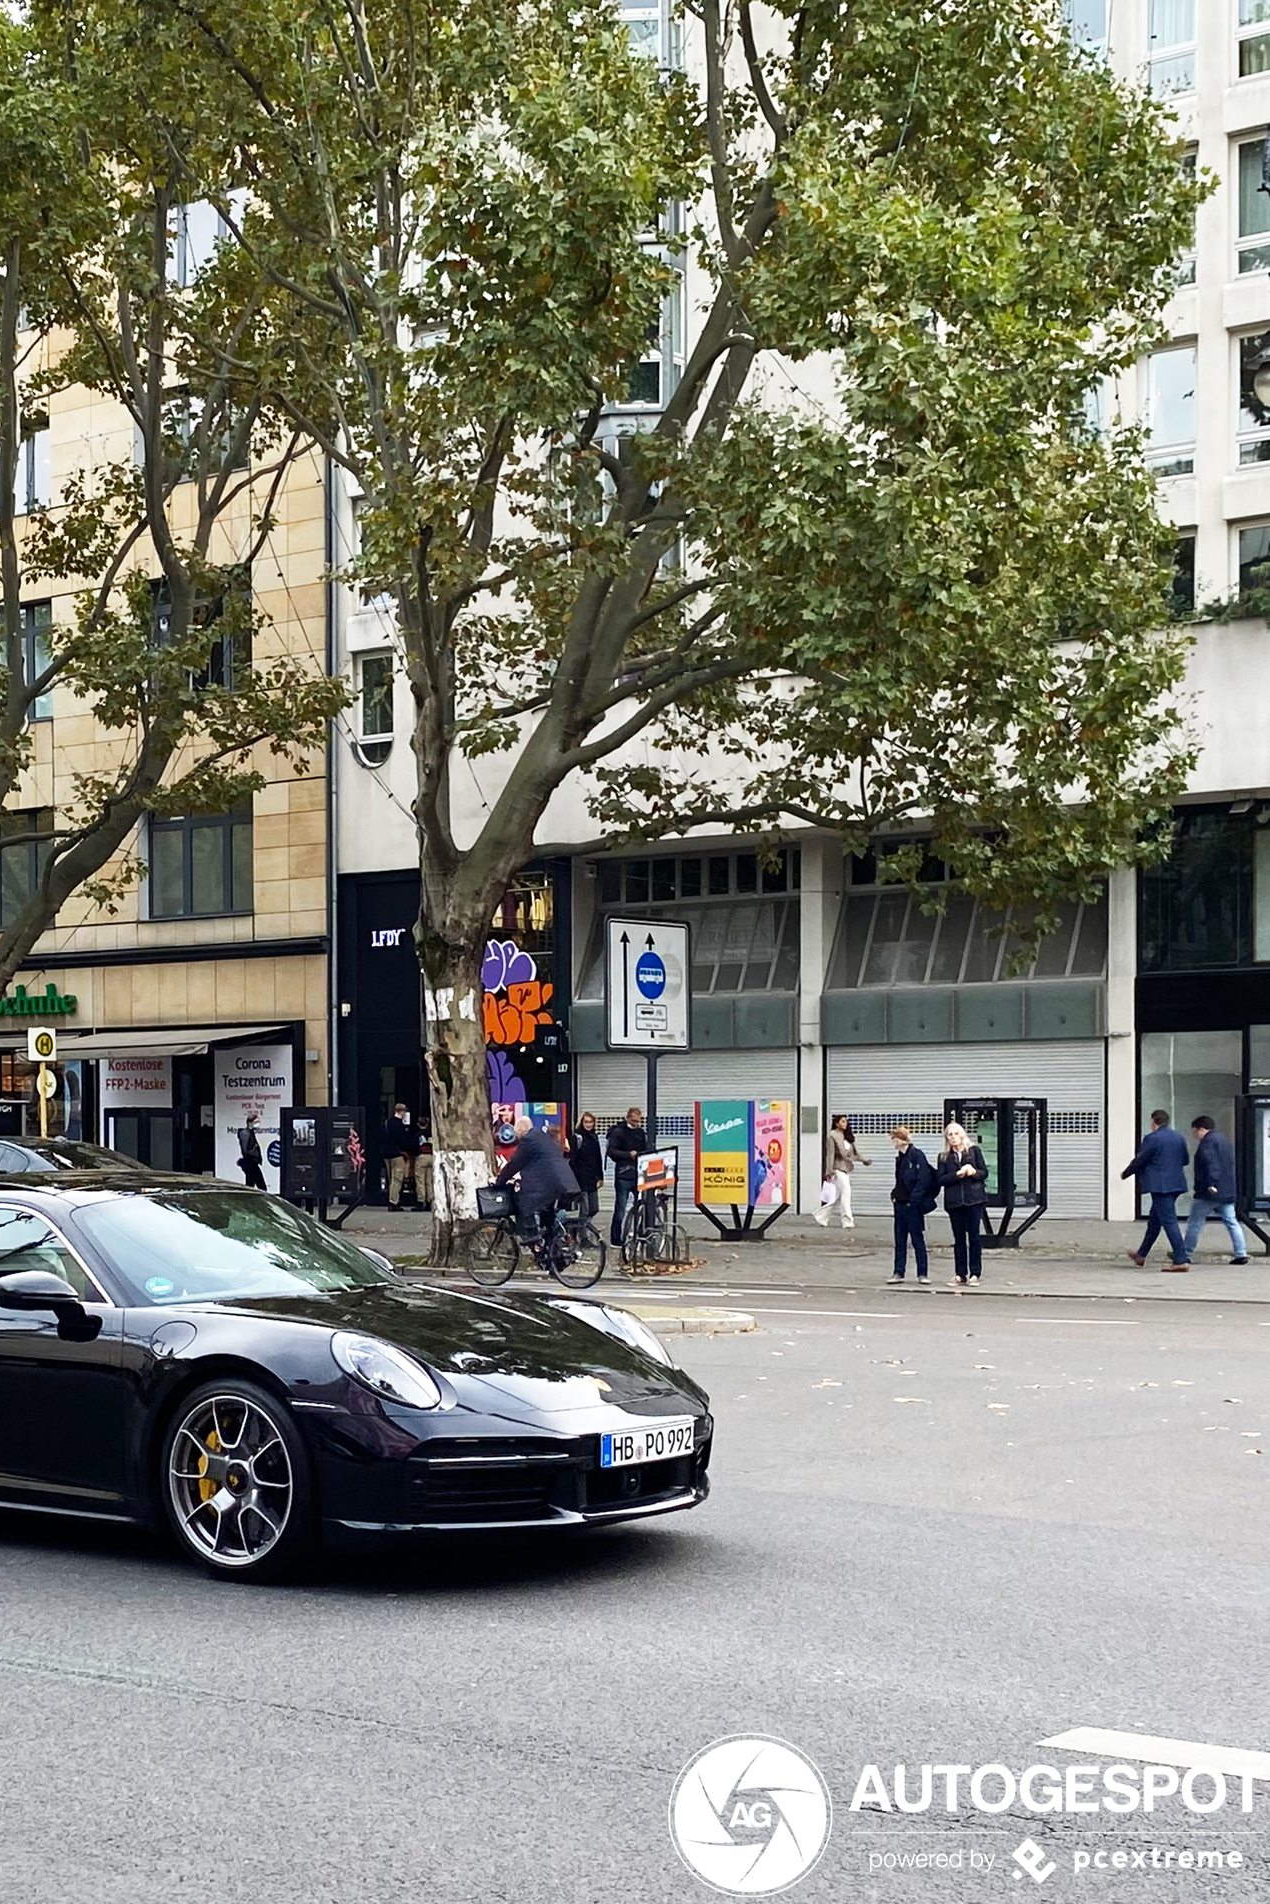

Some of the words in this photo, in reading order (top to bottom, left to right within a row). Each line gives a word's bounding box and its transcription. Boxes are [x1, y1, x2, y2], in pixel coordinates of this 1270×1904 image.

[40, 1038, 50, 1051] H
[108, 1058, 164, 1072] Kostenlose
[235, 1057, 271, 1070] Corona
[105, 1077, 167, 1091] FFP2-Maske
[222, 1075, 286, 1088] Testzentrum
[703, 1174, 745, 1184] KÖNIG
[613, 1436, 634, 1462] HB
[667, 1426, 692, 1454] 992
